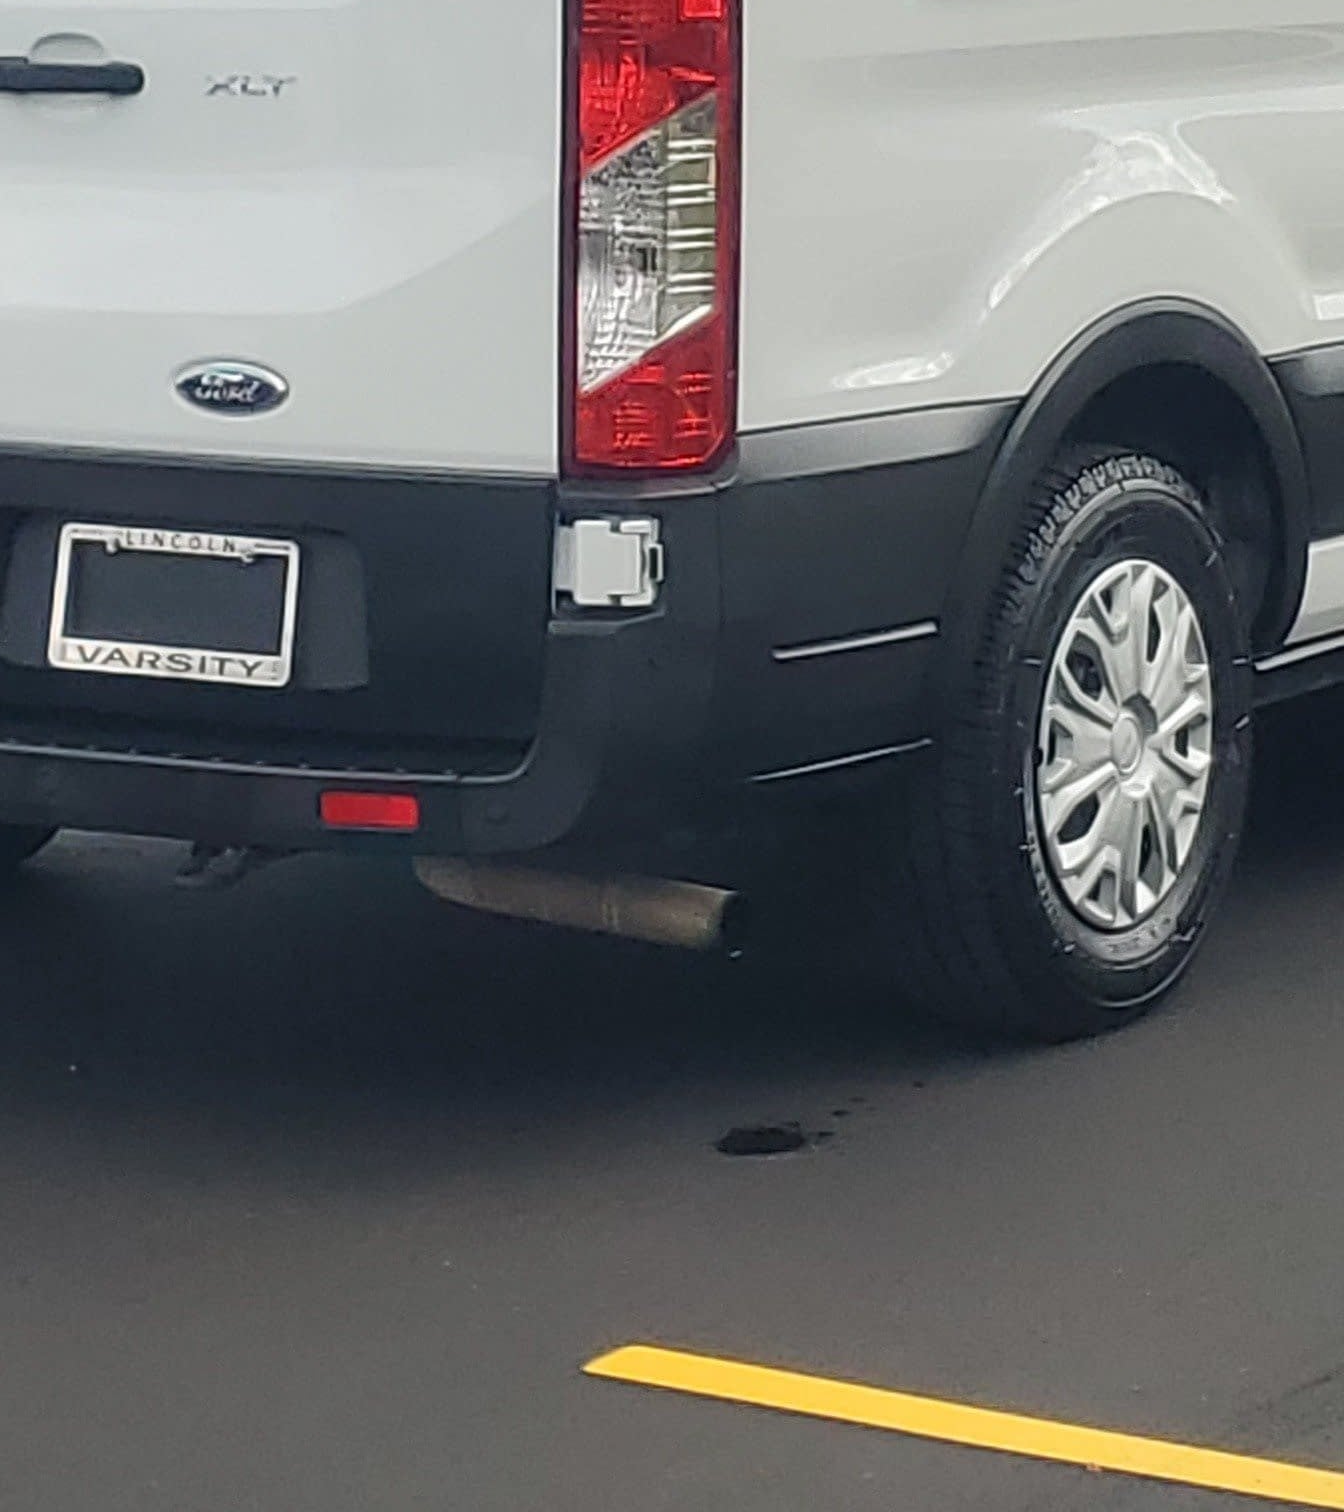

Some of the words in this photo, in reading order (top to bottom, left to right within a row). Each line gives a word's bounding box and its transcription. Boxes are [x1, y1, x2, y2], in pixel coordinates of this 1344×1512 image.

[203, 73, 298, 98] XLT
[196, 371, 260, 403] Ford
[126, 530, 237, 554] LINCOLN
[77, 645, 262, 678] VARSITY
